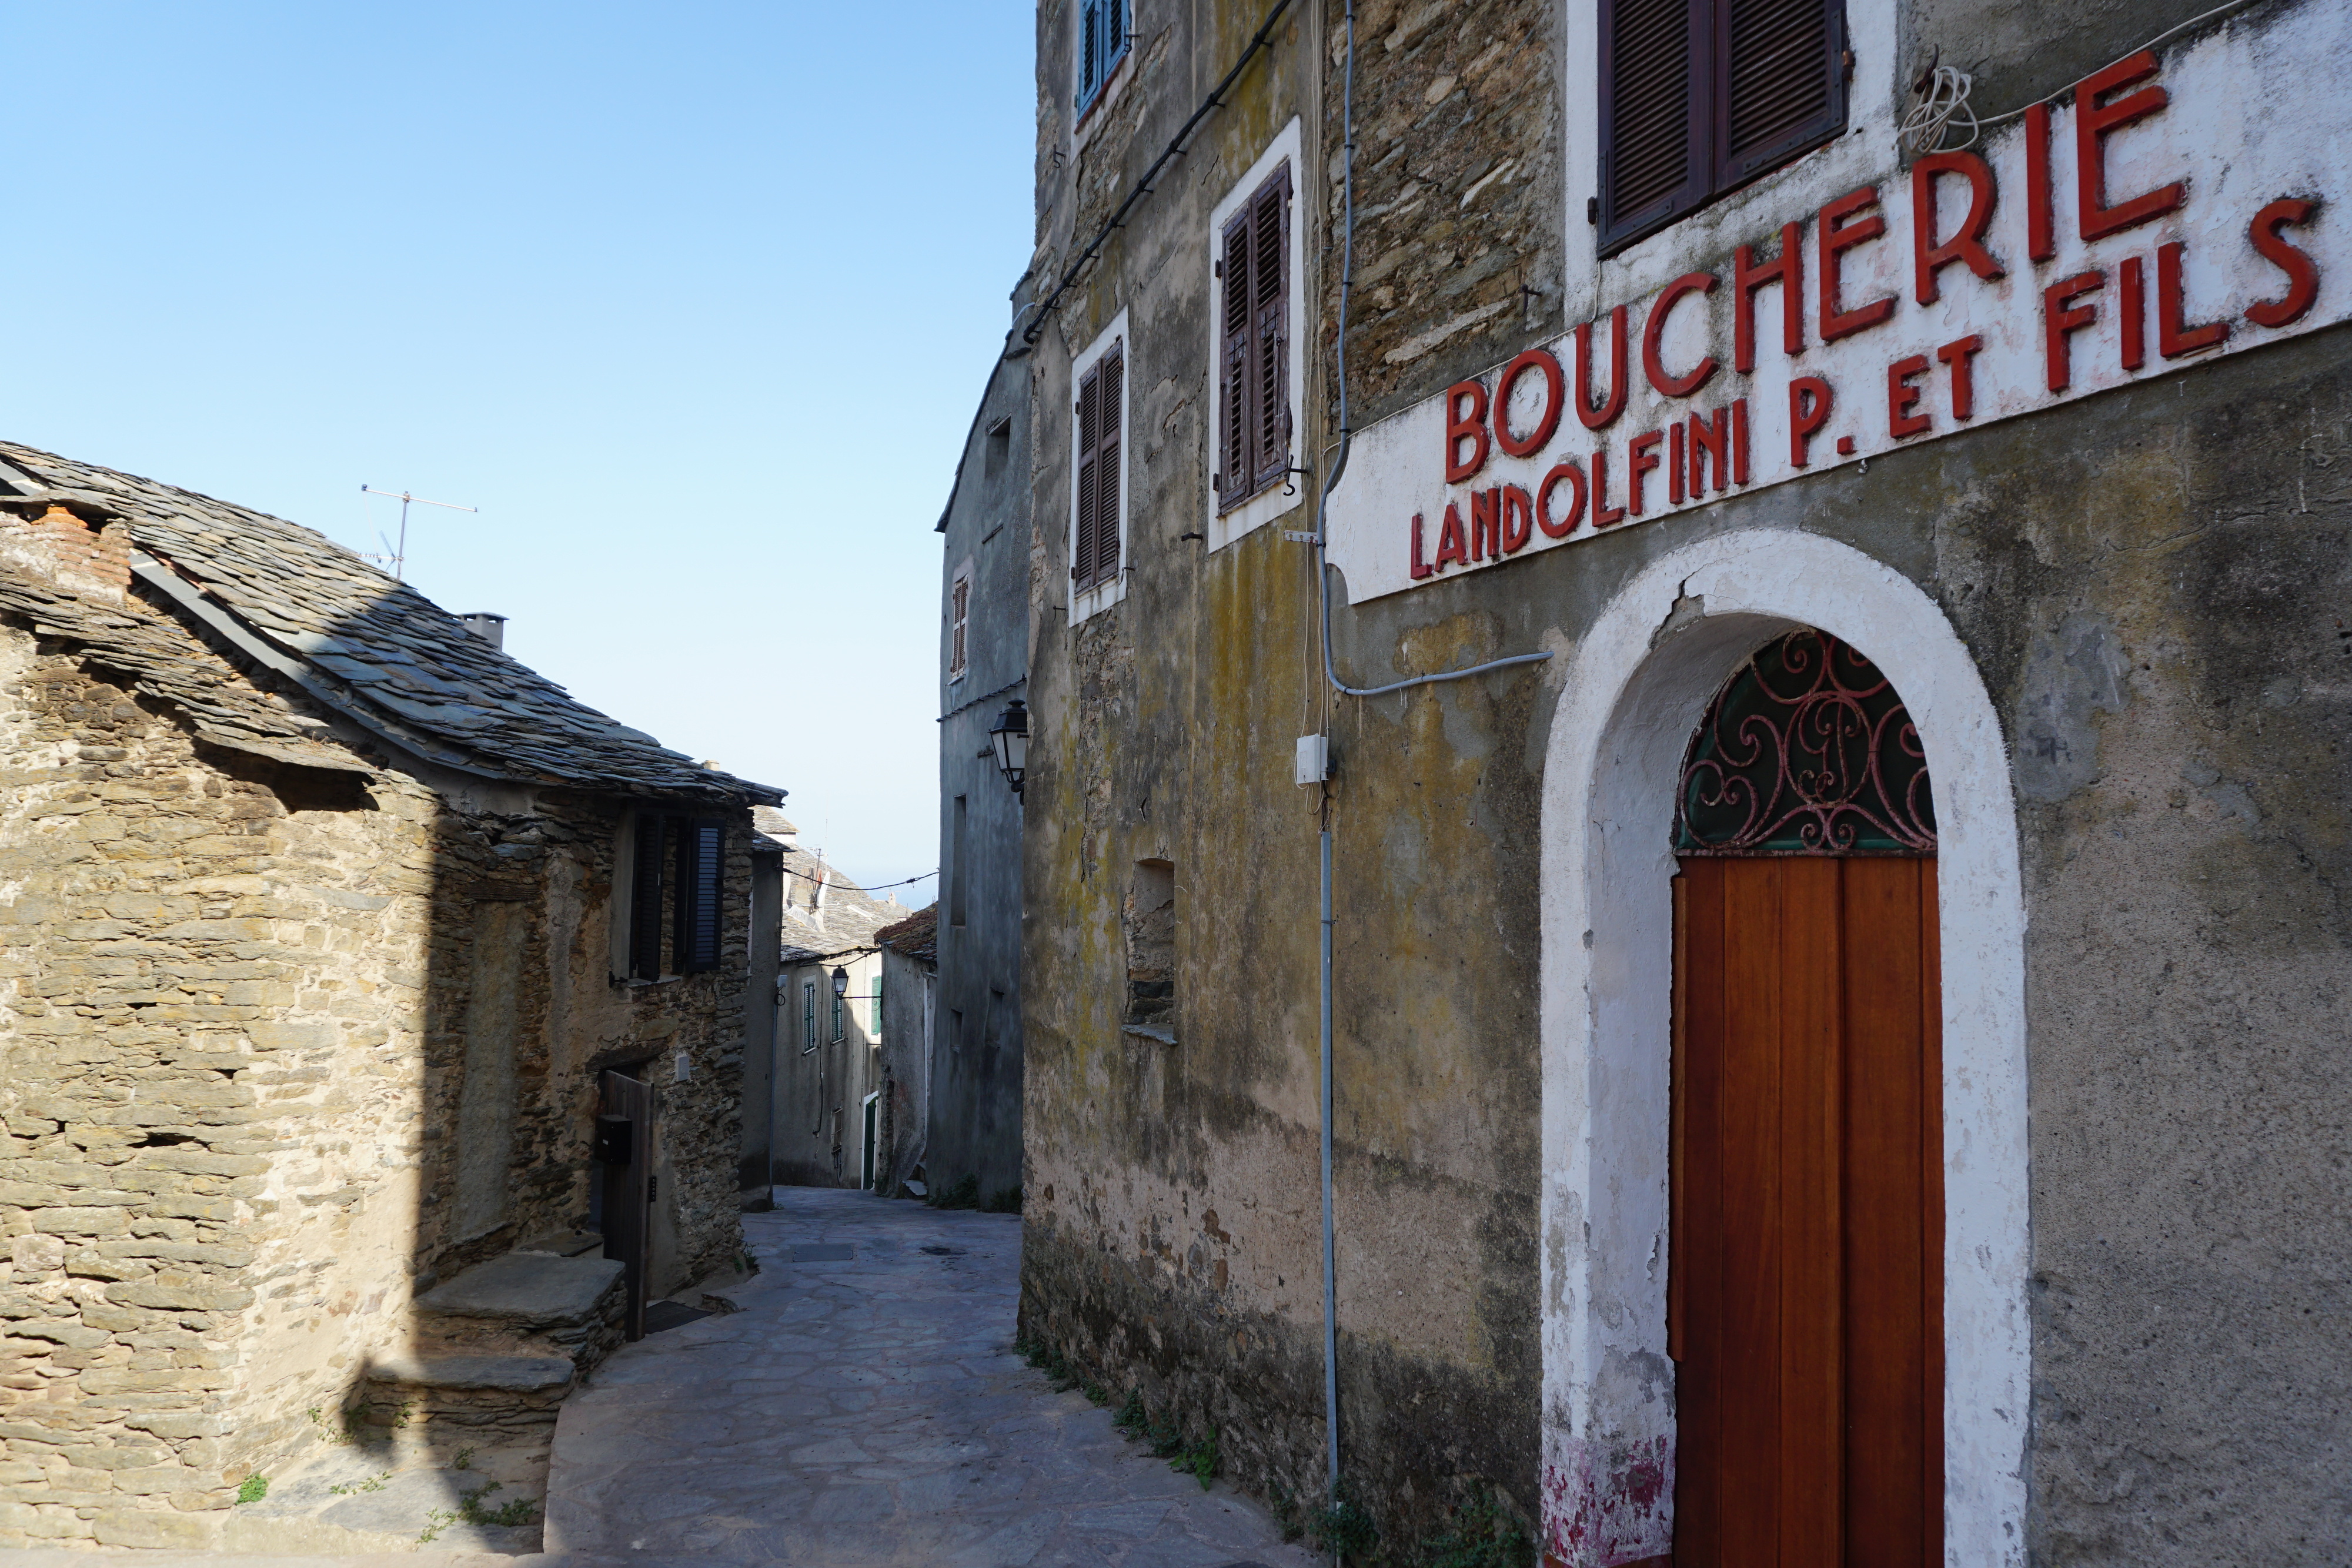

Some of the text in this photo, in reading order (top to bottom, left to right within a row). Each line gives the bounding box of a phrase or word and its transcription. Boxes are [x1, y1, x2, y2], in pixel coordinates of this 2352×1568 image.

[1410, 199, 2320, 580] LANDOLFINI P. ET FILS
[1446, 49, 2186, 484] BOUCHERIE
